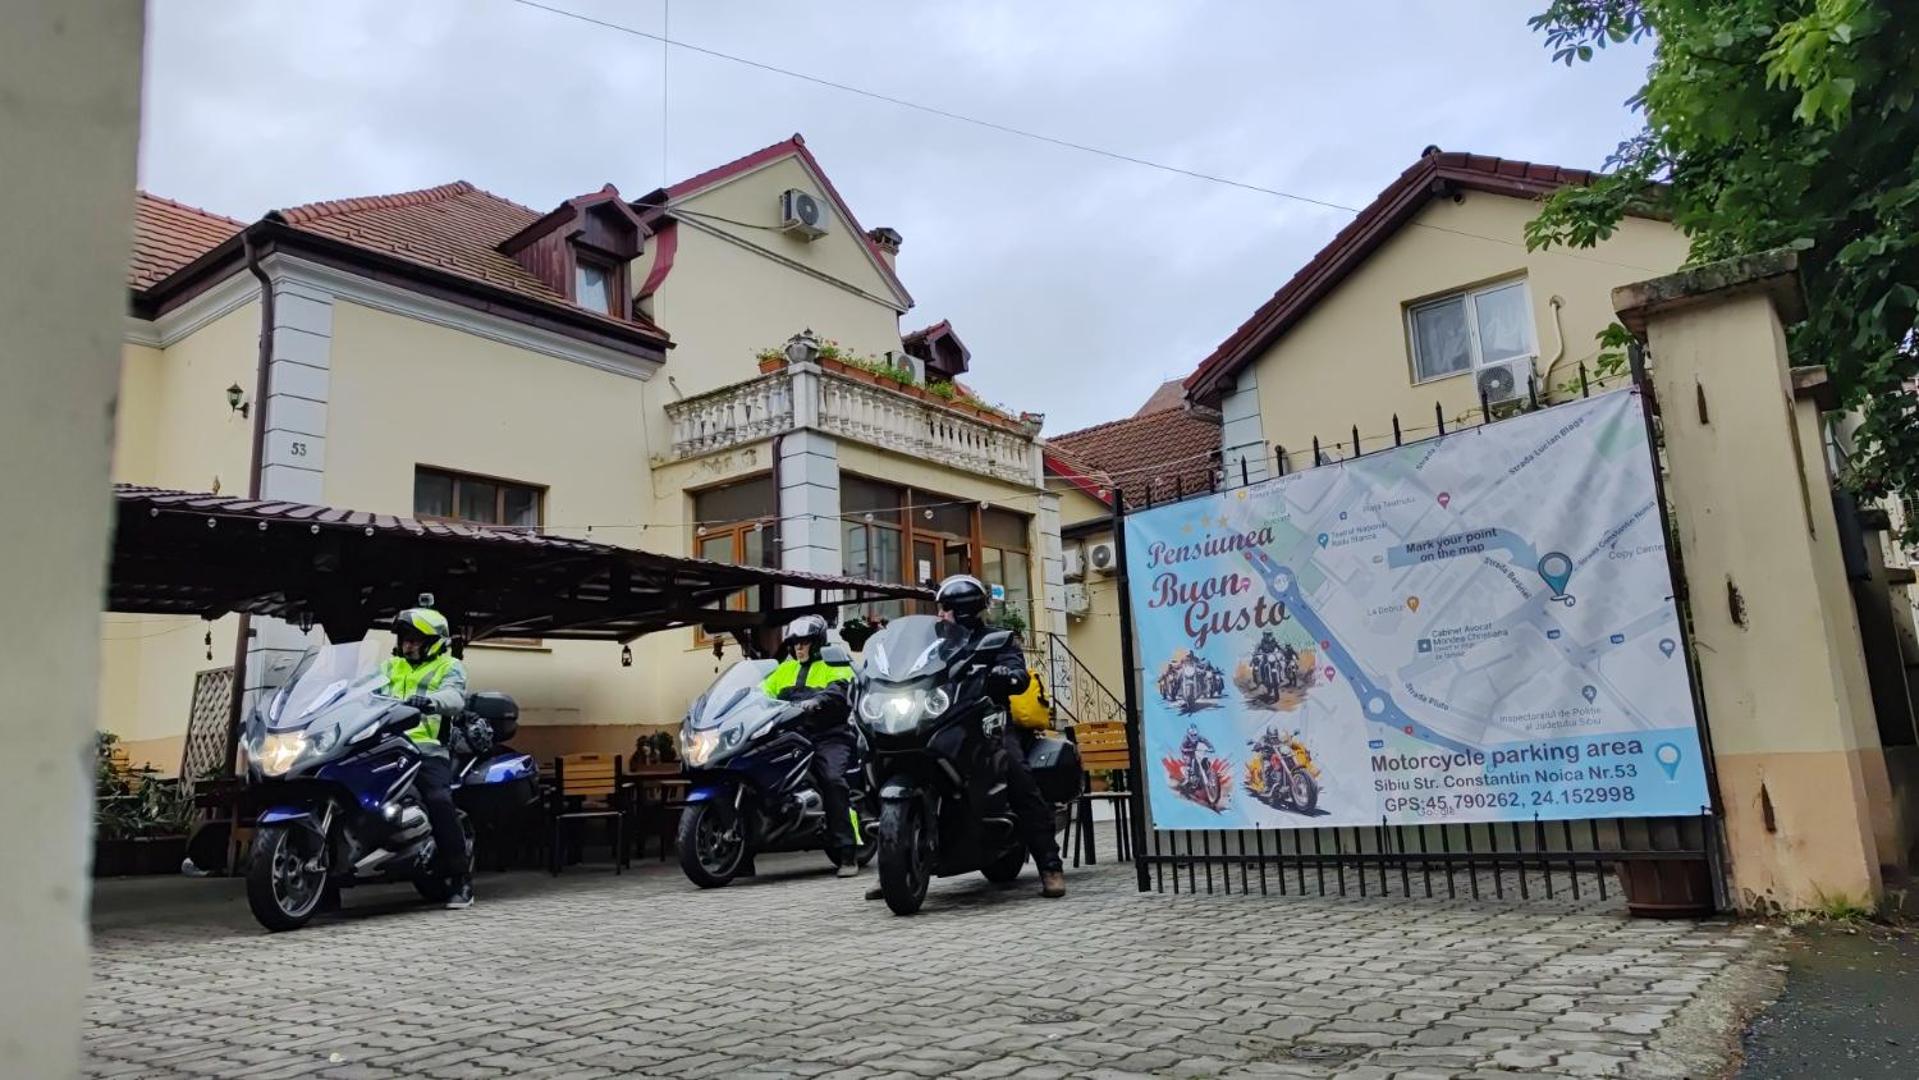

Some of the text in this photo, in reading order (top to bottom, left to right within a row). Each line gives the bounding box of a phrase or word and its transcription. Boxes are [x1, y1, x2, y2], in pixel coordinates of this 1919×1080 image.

[291, 442, 307, 456] 53
[1508, 417, 1585, 475] Strada Lucian Blaga
[1147, 526, 1275, 569] Pensiunea
[1406, 527, 1498, 554] Mark your point
[1420, 542, 1485, 563] on the map
[1608, 549, 1633, 561] Copy
[1148, 572, 1241, 608] Buon
[1184, 595, 1291, 650] Gusto
[1464, 622, 1492, 633] Avocat
[1405, 682, 1428, 703] Strada
[1371, 738, 1644, 773] Motorcycle parking area
[1374, 763, 1638, 792] Sibiu Str. Constantin Noica Nr.53
[1530, 786, 1636, 806] 24.152998
